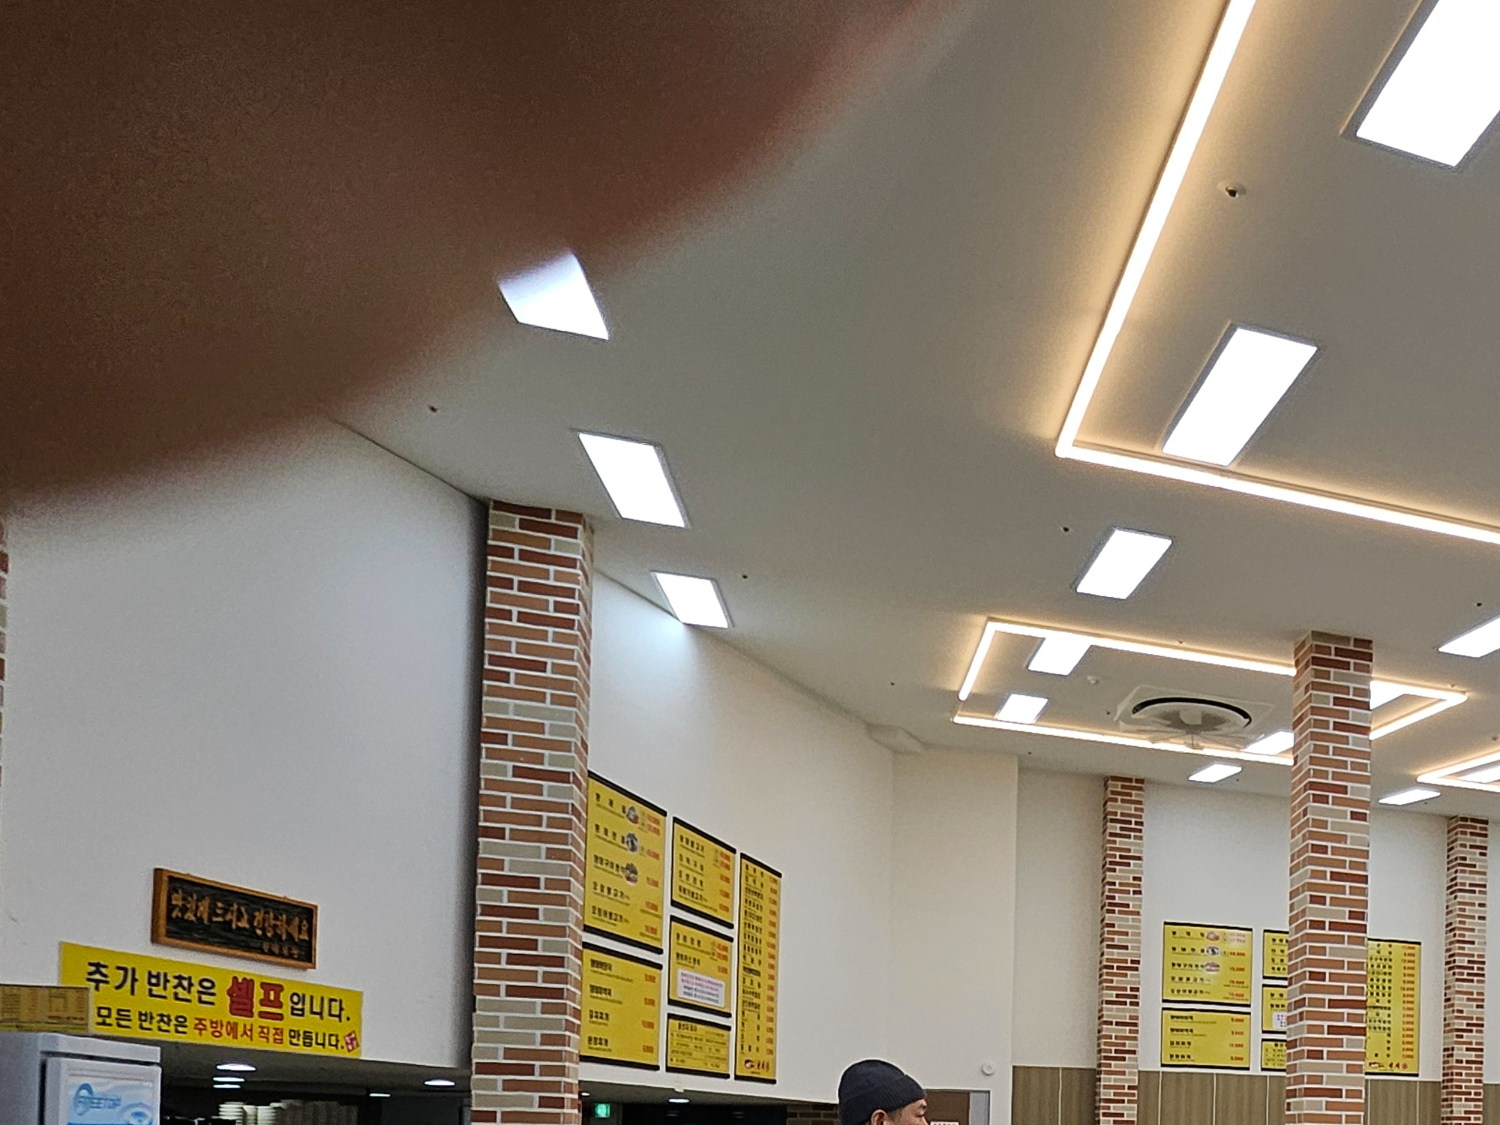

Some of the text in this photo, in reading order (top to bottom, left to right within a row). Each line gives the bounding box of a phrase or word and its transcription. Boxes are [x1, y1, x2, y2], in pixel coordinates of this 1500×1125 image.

[85, 961, 351, 1023] 추가 반찬은 셀프 입니다.
[95, 1006, 133, 1030] 모든
[138, 1010, 188, 1035] 반찬은
[193, 1017, 254, 1041] 주방에서
[257, 1024, 284, 1045] 직접
[288, 1028, 345, 1050] 만듭니다.
